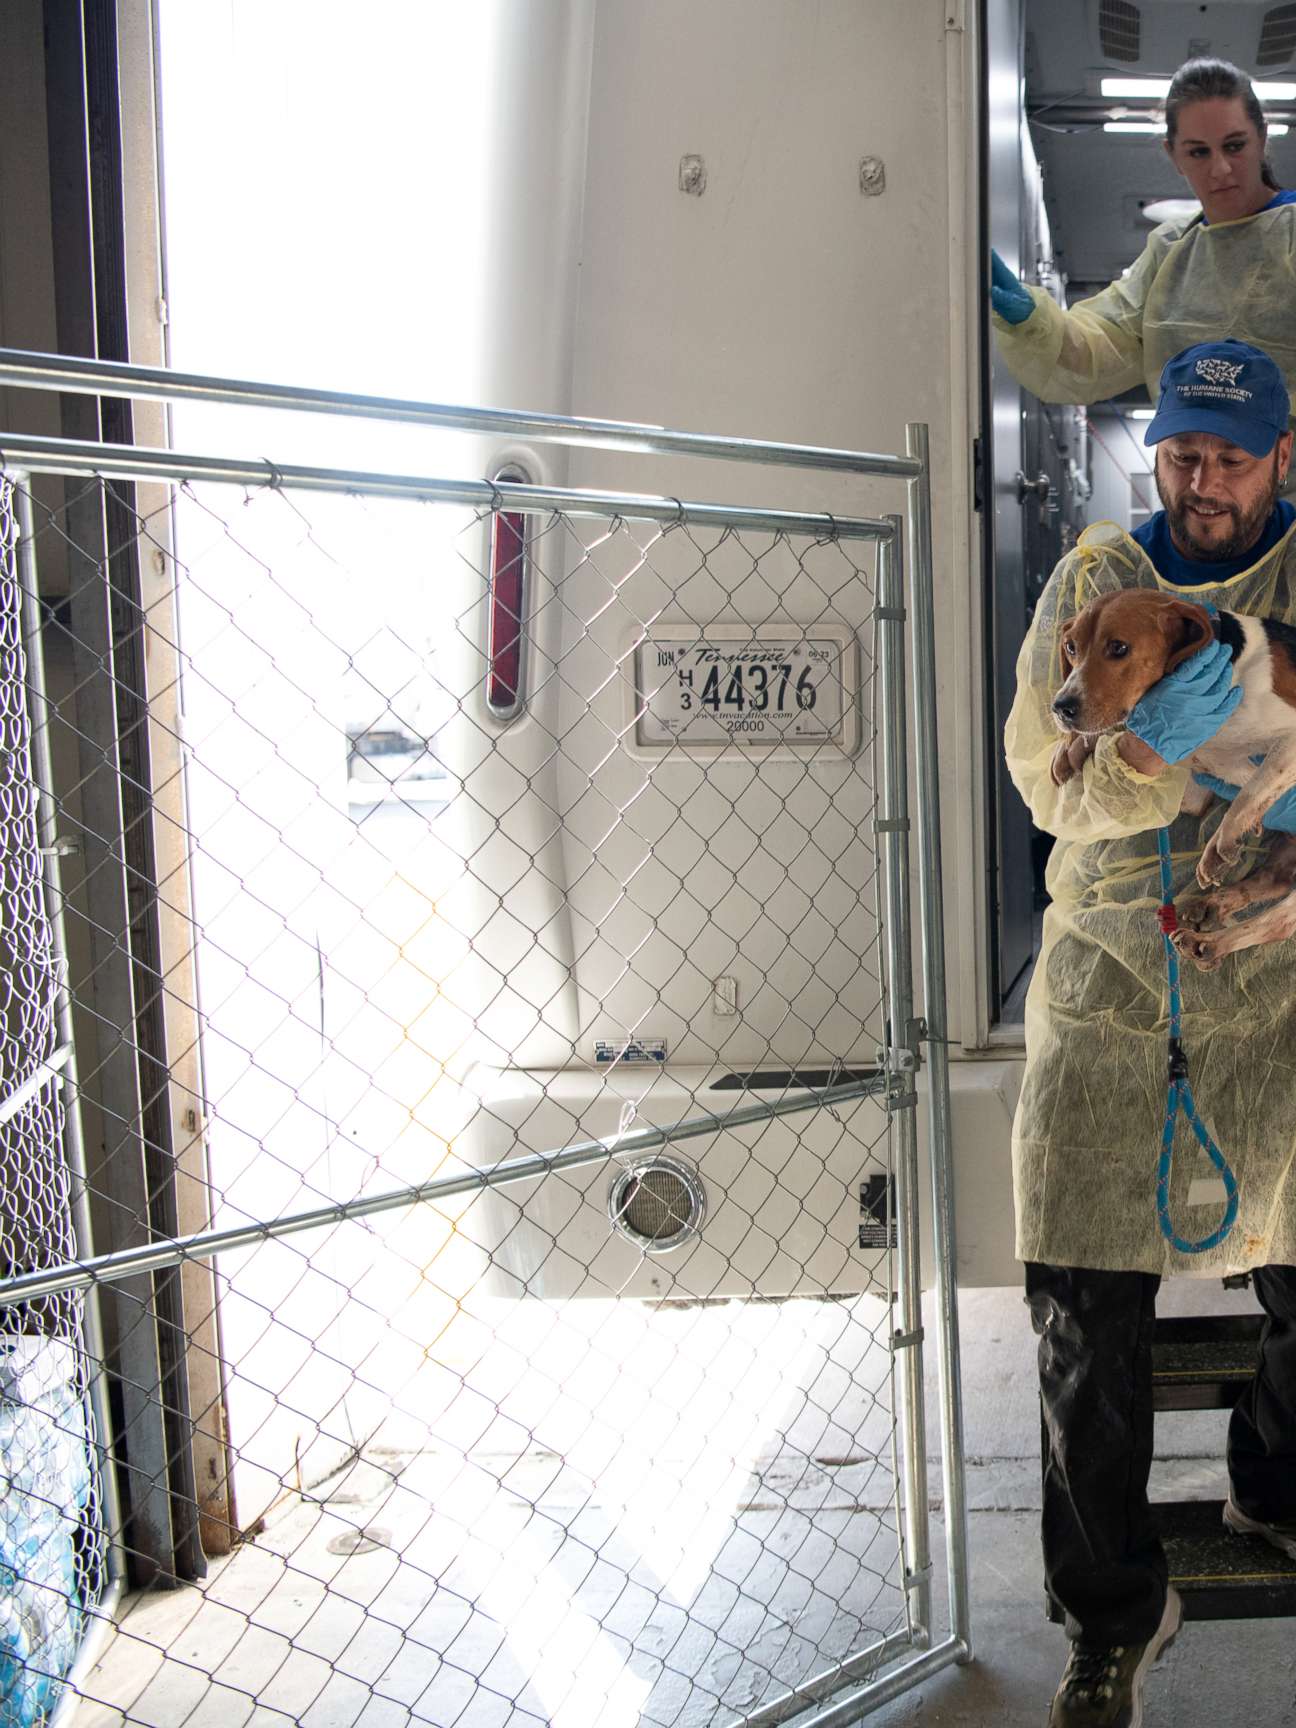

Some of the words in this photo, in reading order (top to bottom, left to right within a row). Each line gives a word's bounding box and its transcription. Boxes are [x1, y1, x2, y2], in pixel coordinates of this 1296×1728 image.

[1191, 384, 1224, 393] HUMANE
[1225, 388, 1253, 400] SOCIETY
[695, 648, 785, 666] Tennessee
[679, 669, 693, 687] H
[701, 664, 817, 711] 44376
[680, 692, 692, 710] 3
[726, 720, 765, 732] 20000
